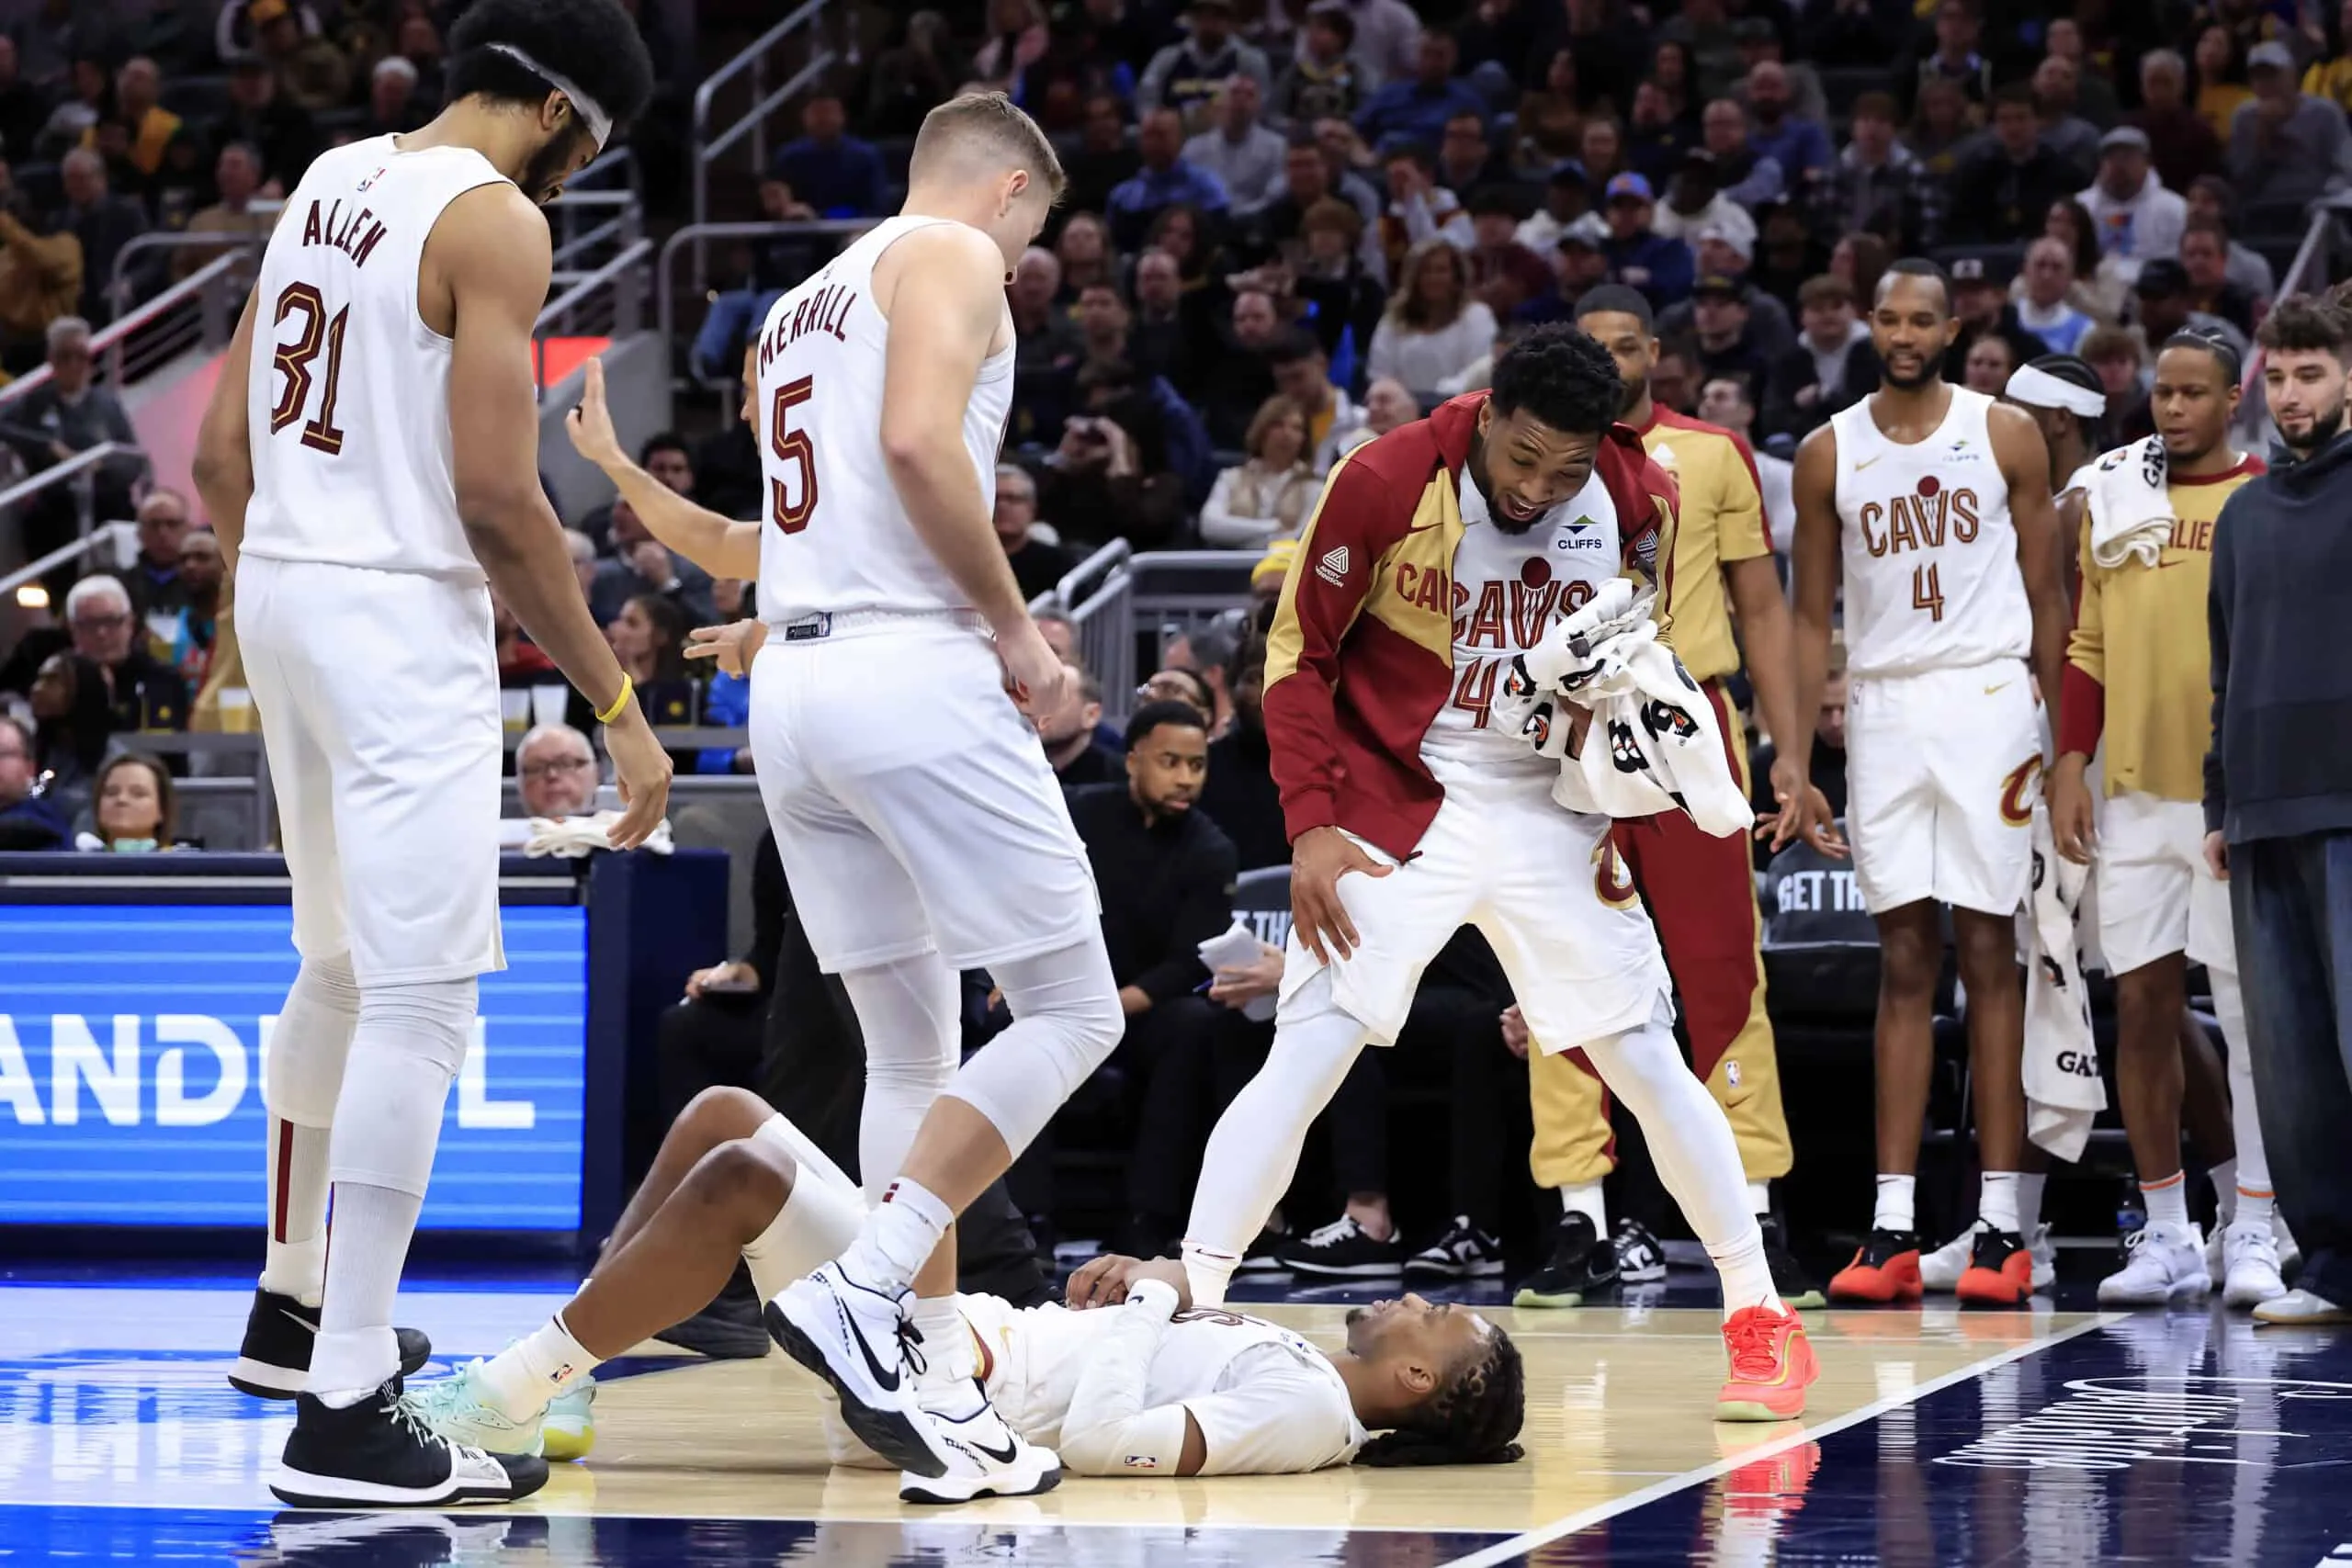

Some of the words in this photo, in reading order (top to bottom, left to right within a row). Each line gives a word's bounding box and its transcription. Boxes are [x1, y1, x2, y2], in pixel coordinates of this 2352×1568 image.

[302, 198, 387, 268] ALLEN
[759, 284, 857, 378] MERRILL
[270, 280, 350, 456] 31
[771, 374, 819, 535] 5
[1557, 538, 1602, 549] CLIFFS
[1860, 487, 1980, 558] CAVS
[1912, 560, 1945, 623] 4
[1777, 870, 1826, 912] GET
